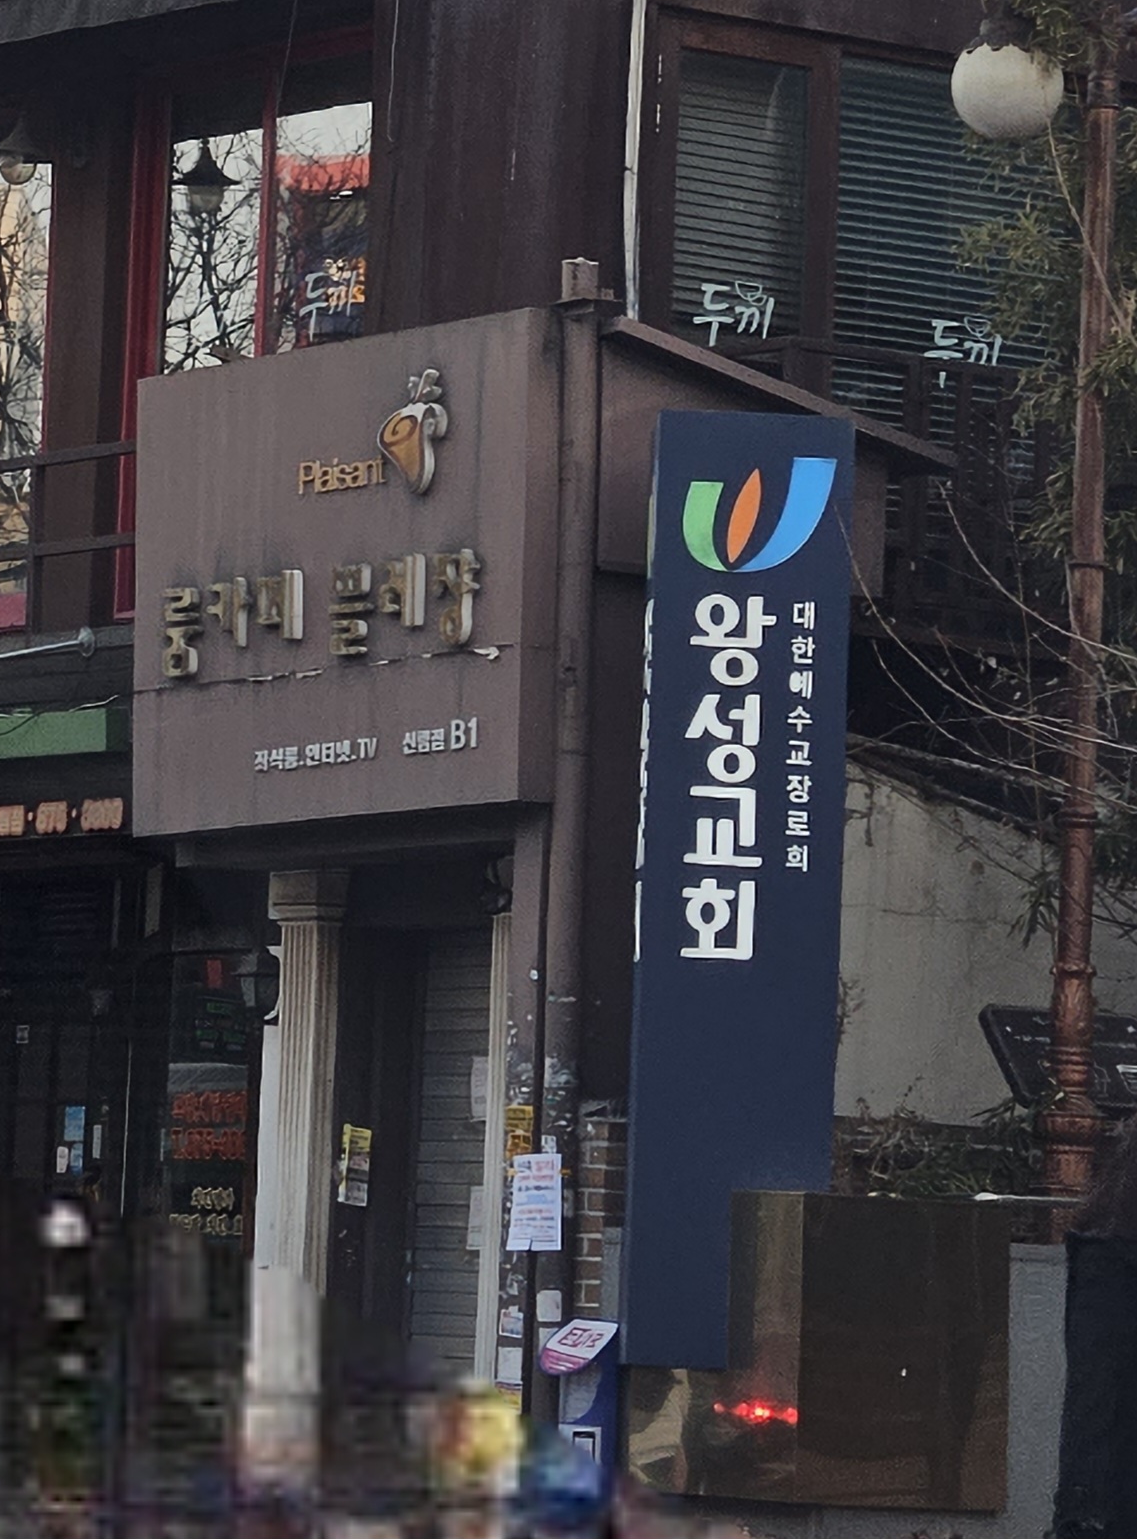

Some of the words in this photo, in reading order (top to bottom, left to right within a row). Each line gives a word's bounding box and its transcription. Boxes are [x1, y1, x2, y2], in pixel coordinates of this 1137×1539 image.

[693, 283, 775, 347] 두끼
[298, 457, 387, 495] Plaisant
[450, 717, 478, 751] B1
[784, 600, 817, 873] 대한예수교장로회
[679, 592, 778, 961] 왕성교회
